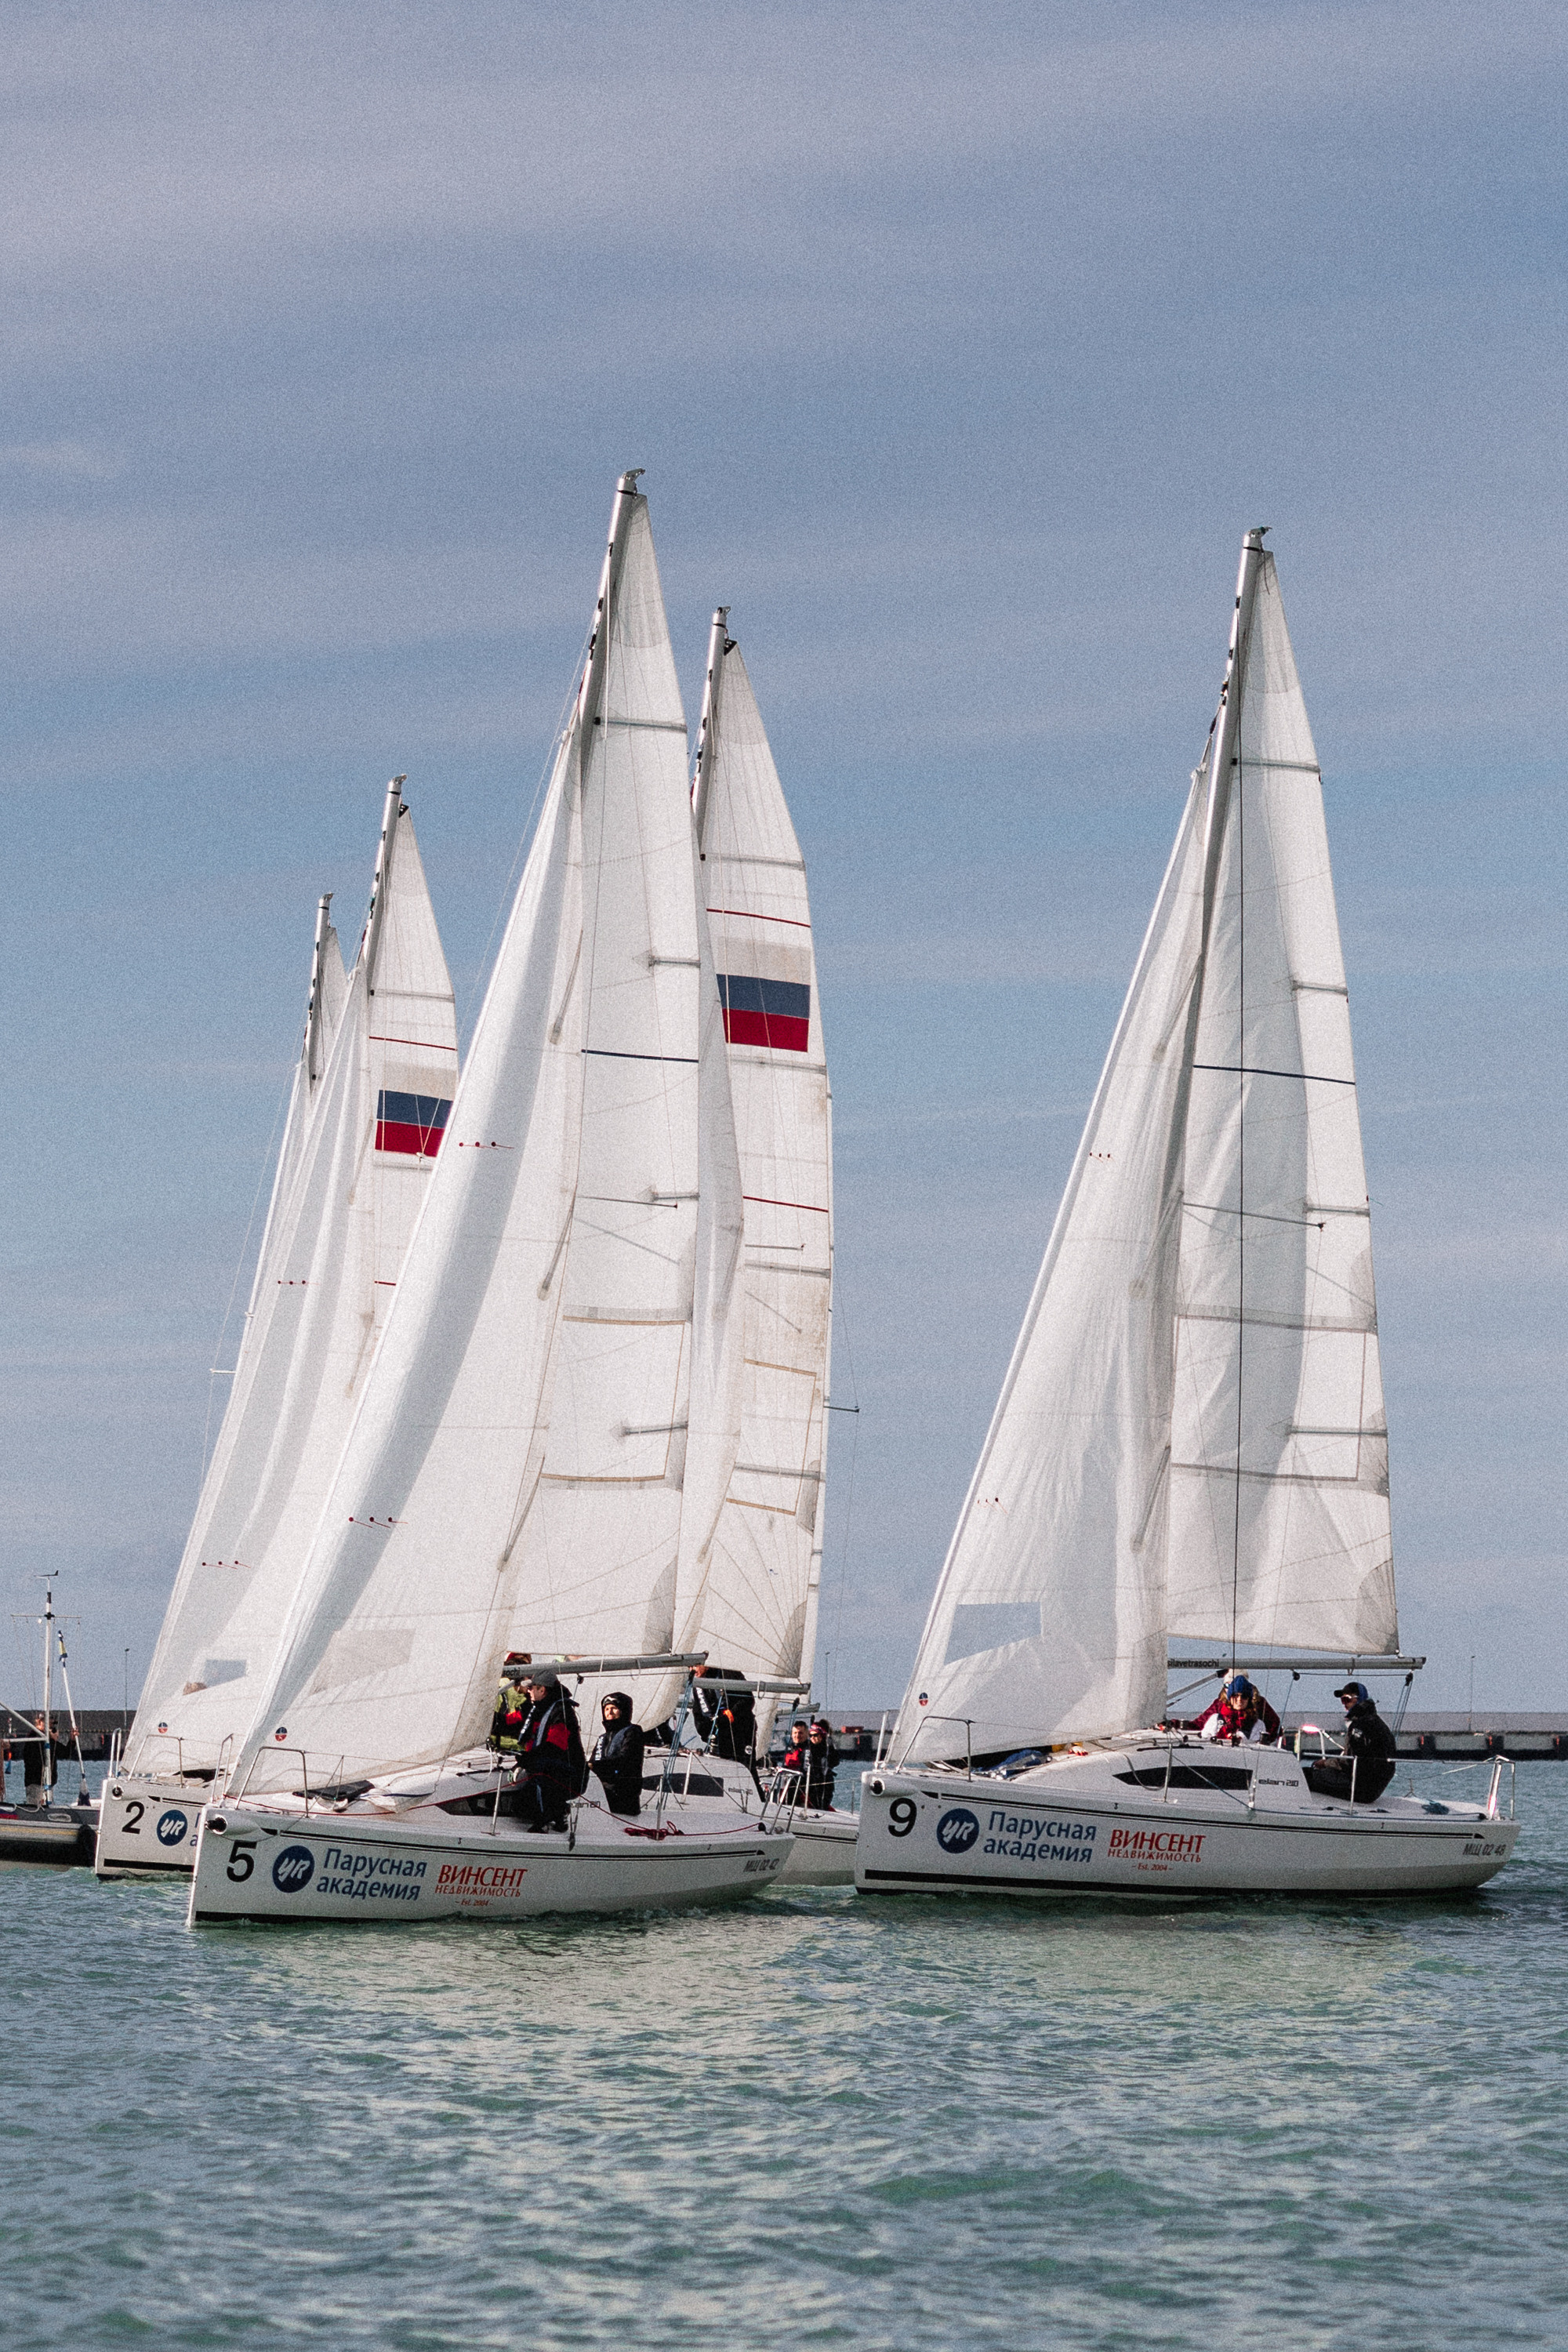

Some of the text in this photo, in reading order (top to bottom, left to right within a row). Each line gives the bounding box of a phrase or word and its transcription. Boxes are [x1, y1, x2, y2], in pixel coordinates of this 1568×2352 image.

[122, 1802, 145, 1835] 2
[888, 1798, 917, 1837] 9
[989, 1811, 1097, 1841] Парусная
[983, 1838, 1093, 1863] академия
[1109, 1829, 1207, 1853] ВИНСЕНТ
[227, 1841, 257, 1882] 5
[324, 1848, 428, 1878] Парусная
[1108, 1849, 1201, 1862] НЕДВИЖИМОСТЬ
[316, 1875, 421, 1901] академия
[437, 1864, 528, 1888] ВИНСЕНТ
[434, 1885, 521, 1897] НЕДВИЖИМОСТЬ
